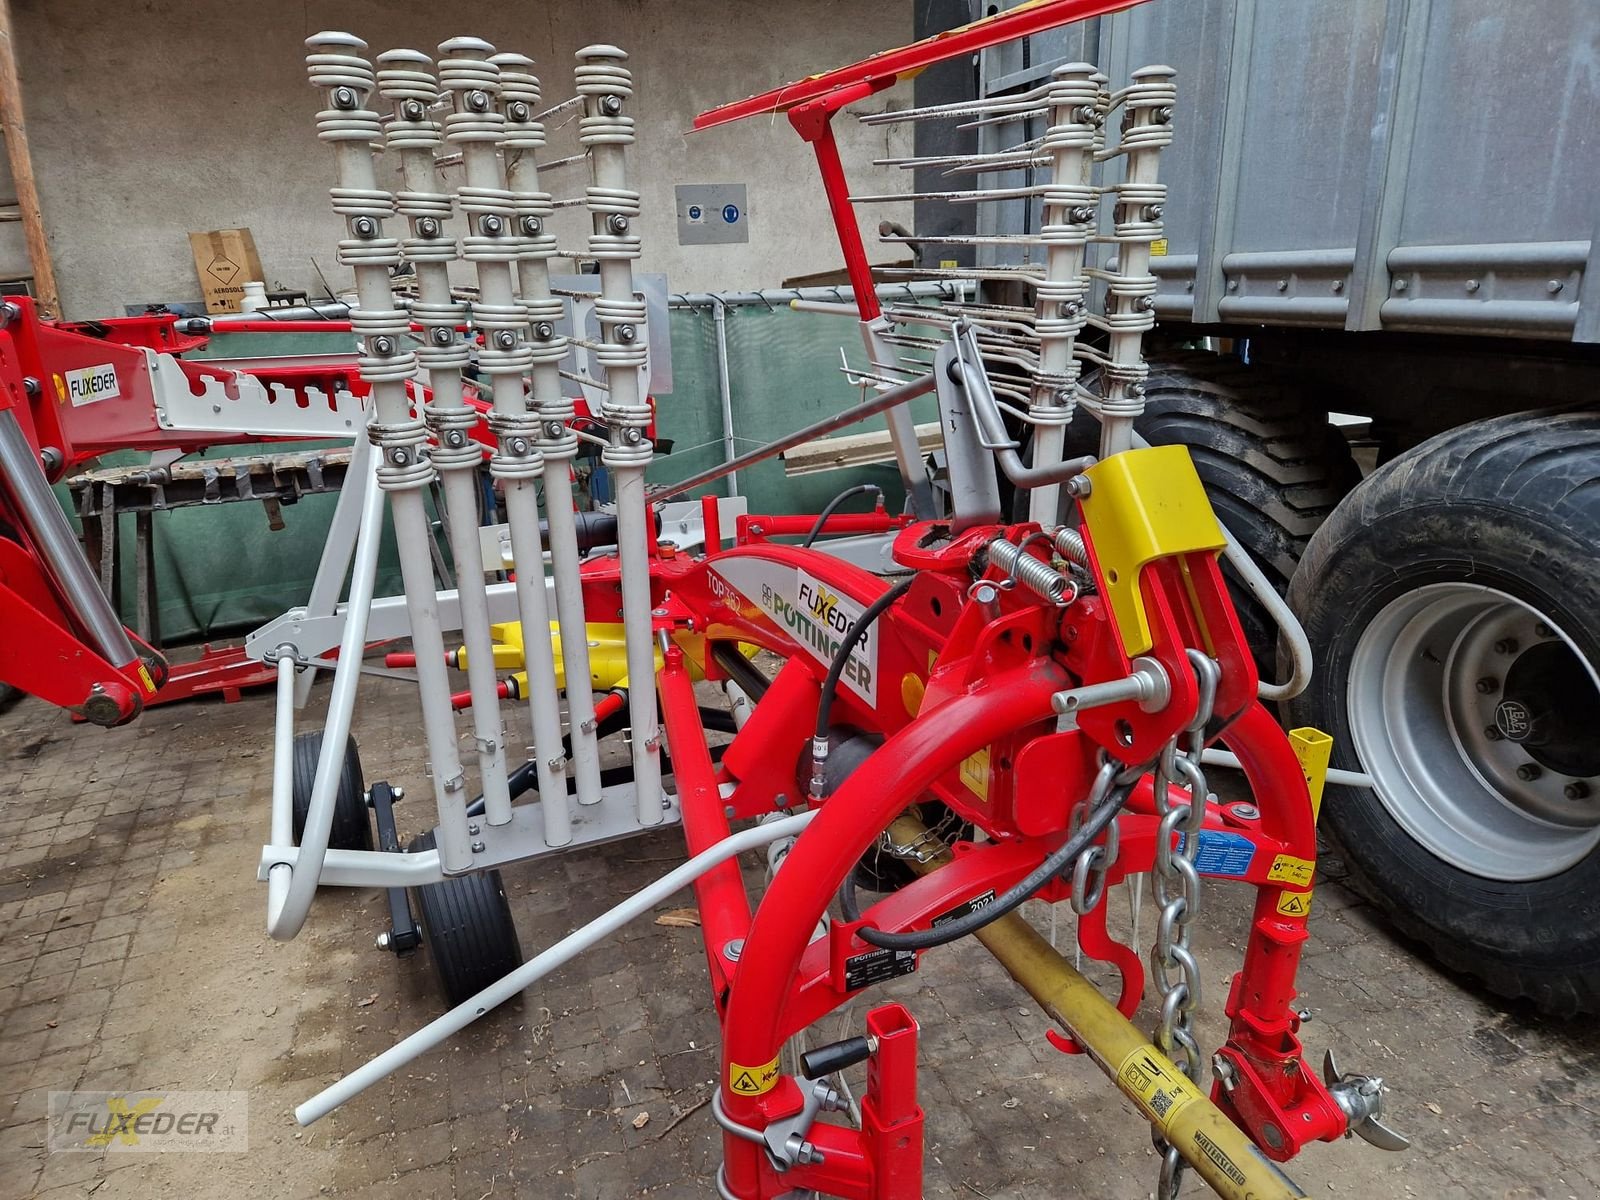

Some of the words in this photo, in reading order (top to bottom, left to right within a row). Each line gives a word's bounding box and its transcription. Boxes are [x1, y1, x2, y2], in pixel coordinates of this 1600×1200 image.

[213, 286, 245, 294] AEROSOLS
[706, 569, 725, 598] TOP
[970, 894, 995, 913] 2021
[1193, 1130, 1246, 1186] WALTERSCHEID
